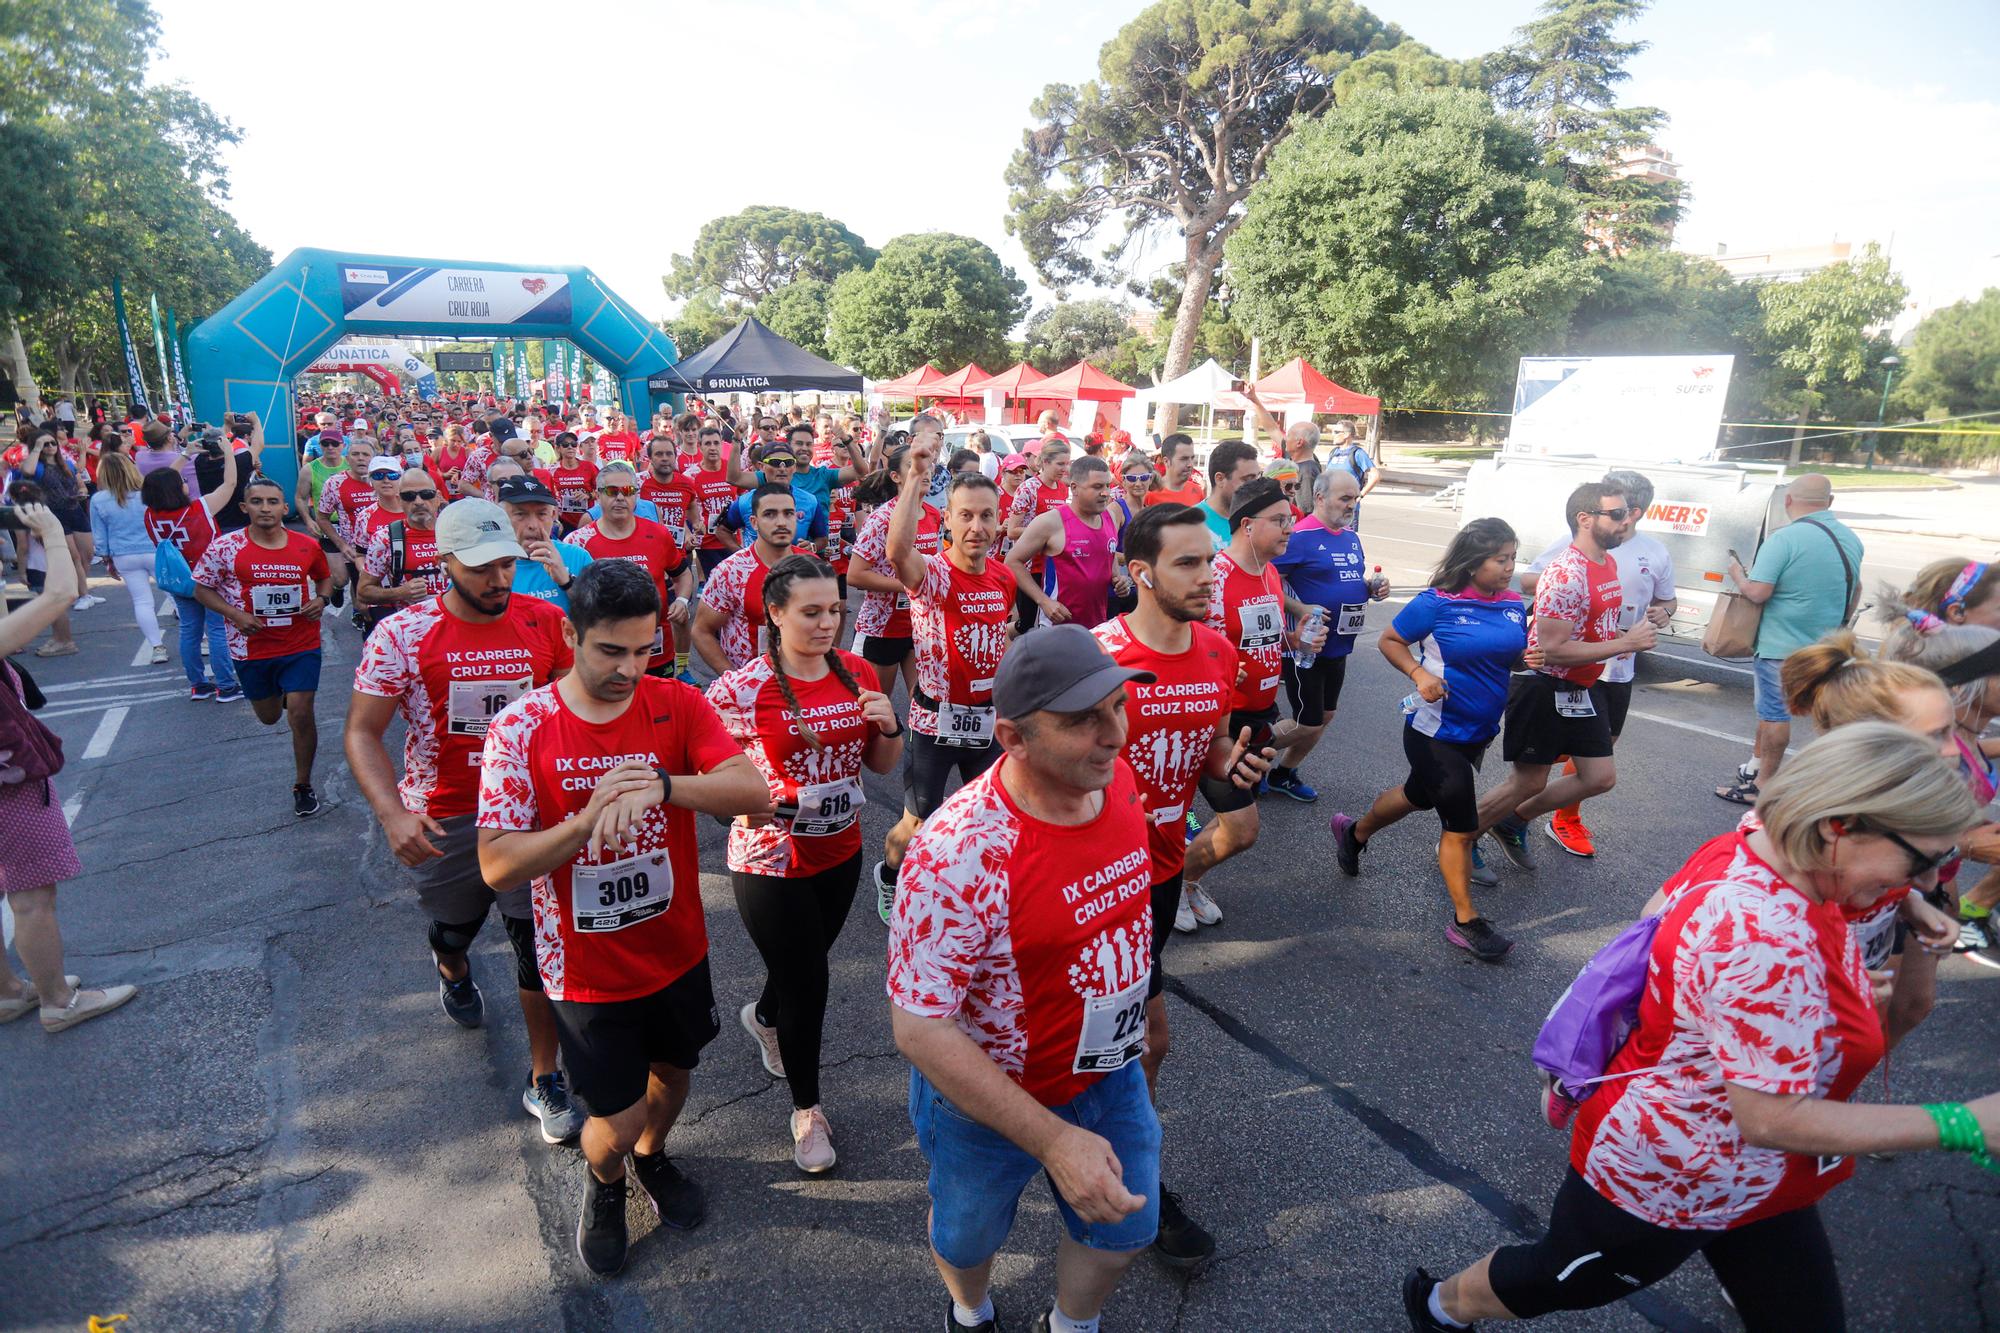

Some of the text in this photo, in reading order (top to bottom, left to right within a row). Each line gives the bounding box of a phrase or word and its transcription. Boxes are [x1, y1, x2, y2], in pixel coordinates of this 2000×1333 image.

[447, 276, 486, 293] CARRERA
[448, 300, 490, 318] CRUZ ROJA
[519, 350, 531, 398] popular
[555, 344, 565, 398] popular
[516, 367, 524, 397] caixa
[549, 362, 557, 398] caixa
[718, 376, 770, 389] RUNÁTICA
[1672, 522, 1701, 532] WORLD
[411, 543, 421, 551] IX
[253, 572, 301, 580] CRUZ ROJA
[267, 592, 290, 605] 769
[957, 591, 1004, 601] IX CARRERA
[960, 603, 1005, 614] CRUZ ROJA
[1257, 613, 1272, 631] 98
[446, 648, 533, 663] IX CARRERA
[451, 663, 533, 679] CRUZ ROJA
[1136, 682, 1219, 699] IX CARRERA
[781, 701, 862, 721] IX CARRERA
[1141, 699, 1219, 716] CRUZ ROJA
[788, 715, 864, 735] CUZ ROJA
[951, 714, 981, 733] 366
[555, 757, 574, 772] IX
[561, 776, 601, 791] CRU
[819, 792, 851, 817] 618
[1062, 846, 1149, 904] IX CARRERA
[598, 871, 650, 907] 309
[1074, 869, 1152, 926] CRUZ ROJA
[595, 918, 618, 926] 42K
